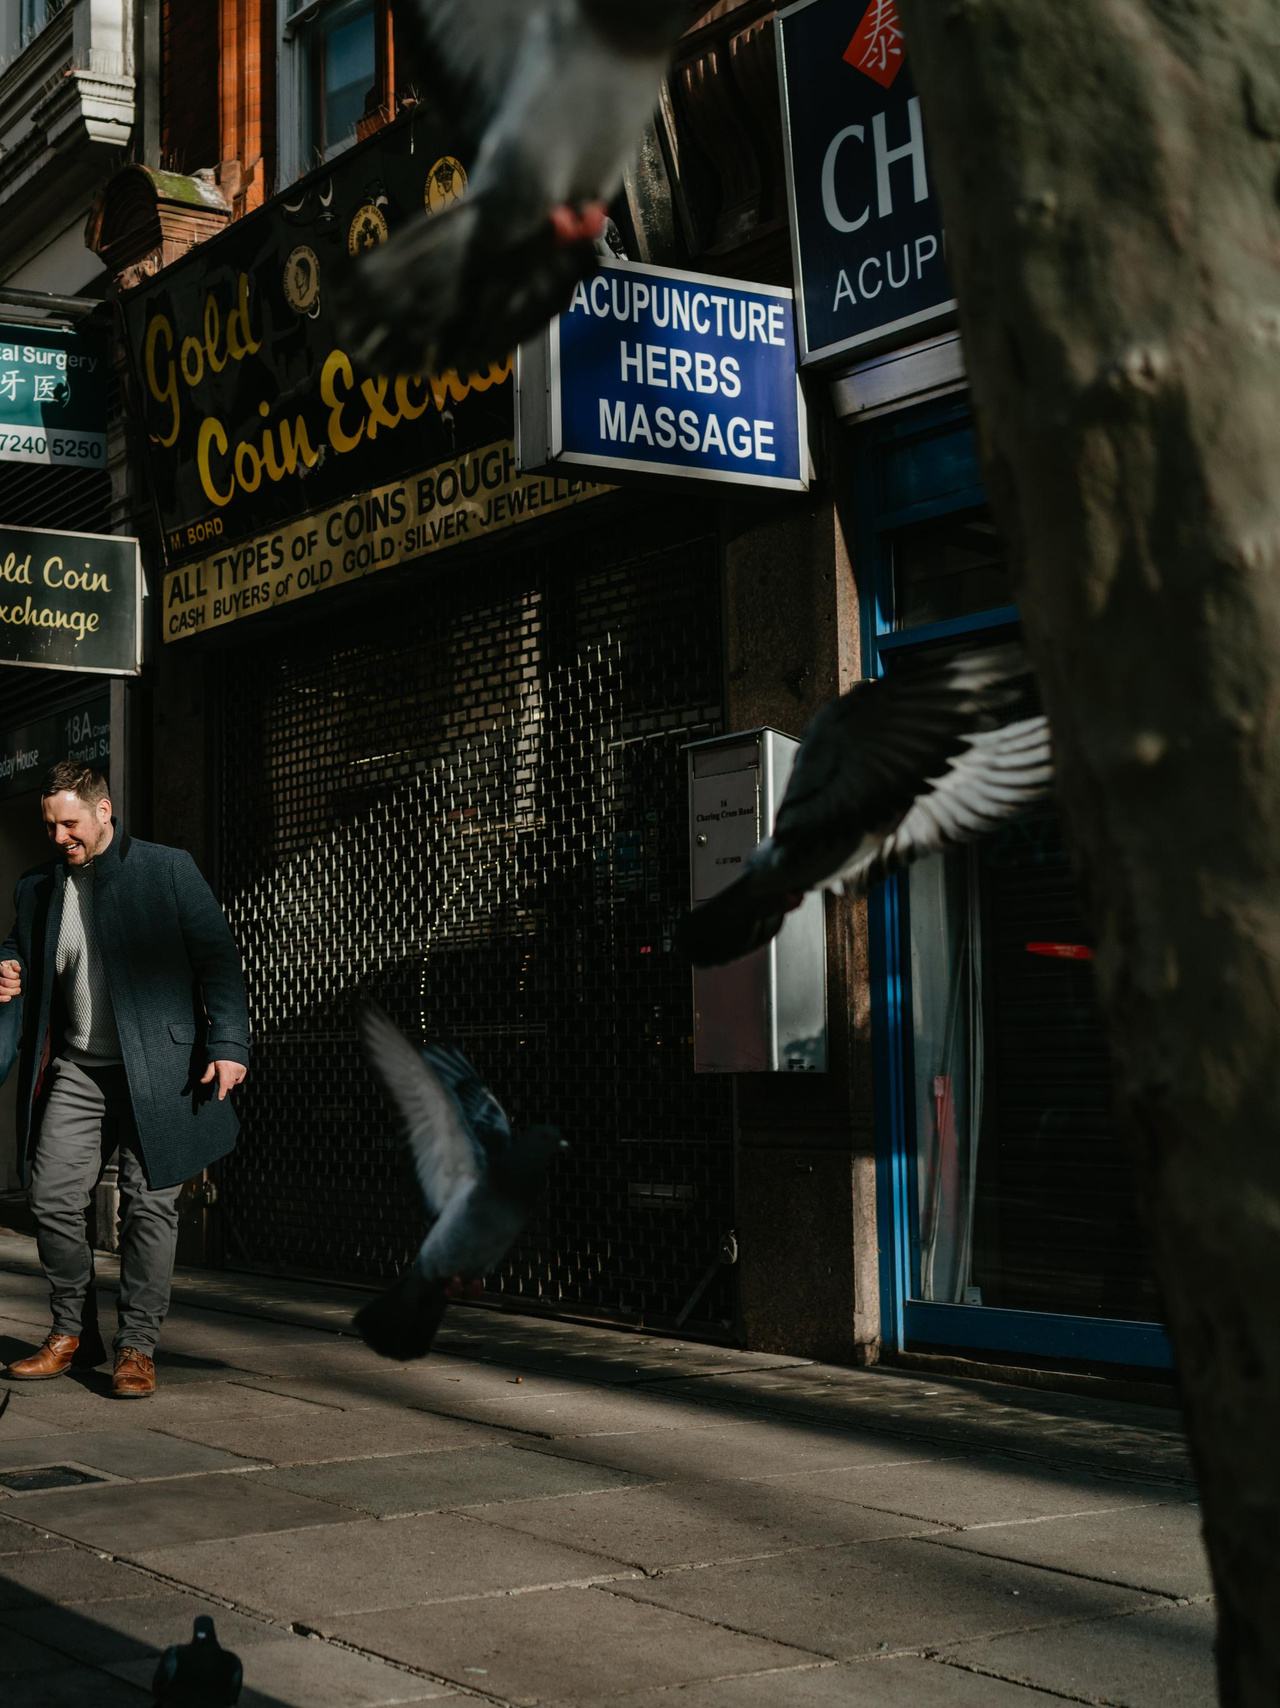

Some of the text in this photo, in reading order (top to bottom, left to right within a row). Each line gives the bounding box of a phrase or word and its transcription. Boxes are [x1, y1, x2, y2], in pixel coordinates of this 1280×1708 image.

[820, 96, 928, 233] CH
[833, 229, 945, 312] ACUP
[568, 275, 787, 347] ACUPUNCTURE
[22, 345, 98, 373] Surgery
[145, 272, 260, 448] Gold
[620, 340, 742, 398] HERBS
[52, 438, 102, 459] 5250
[197, 400, 320, 507] Coin
[598, 398, 777, 462] MASSAGE
[168, 567, 208, 608] ALL
[213, 535, 284, 591] TYPES
[291, 530, 319, 561] OF
[326, 487, 406, 547] COINS
[170, 516, 224, 551] M. BORD
[43, 555, 112, 592] Coin
[169, 605, 205, 635] CASH
[213, 581, 271, 619] BUYERS
[275, 573, 293, 598] of
[297, 559, 333, 590] OLD
[343, 537, 395, 573] GOLD
[404, 509, 469, 552] SILVER
[64, 711, 92, 745] 18A
[16, 749, 39, 771] House
[696, 805, 754, 822] Charing Cross Road
